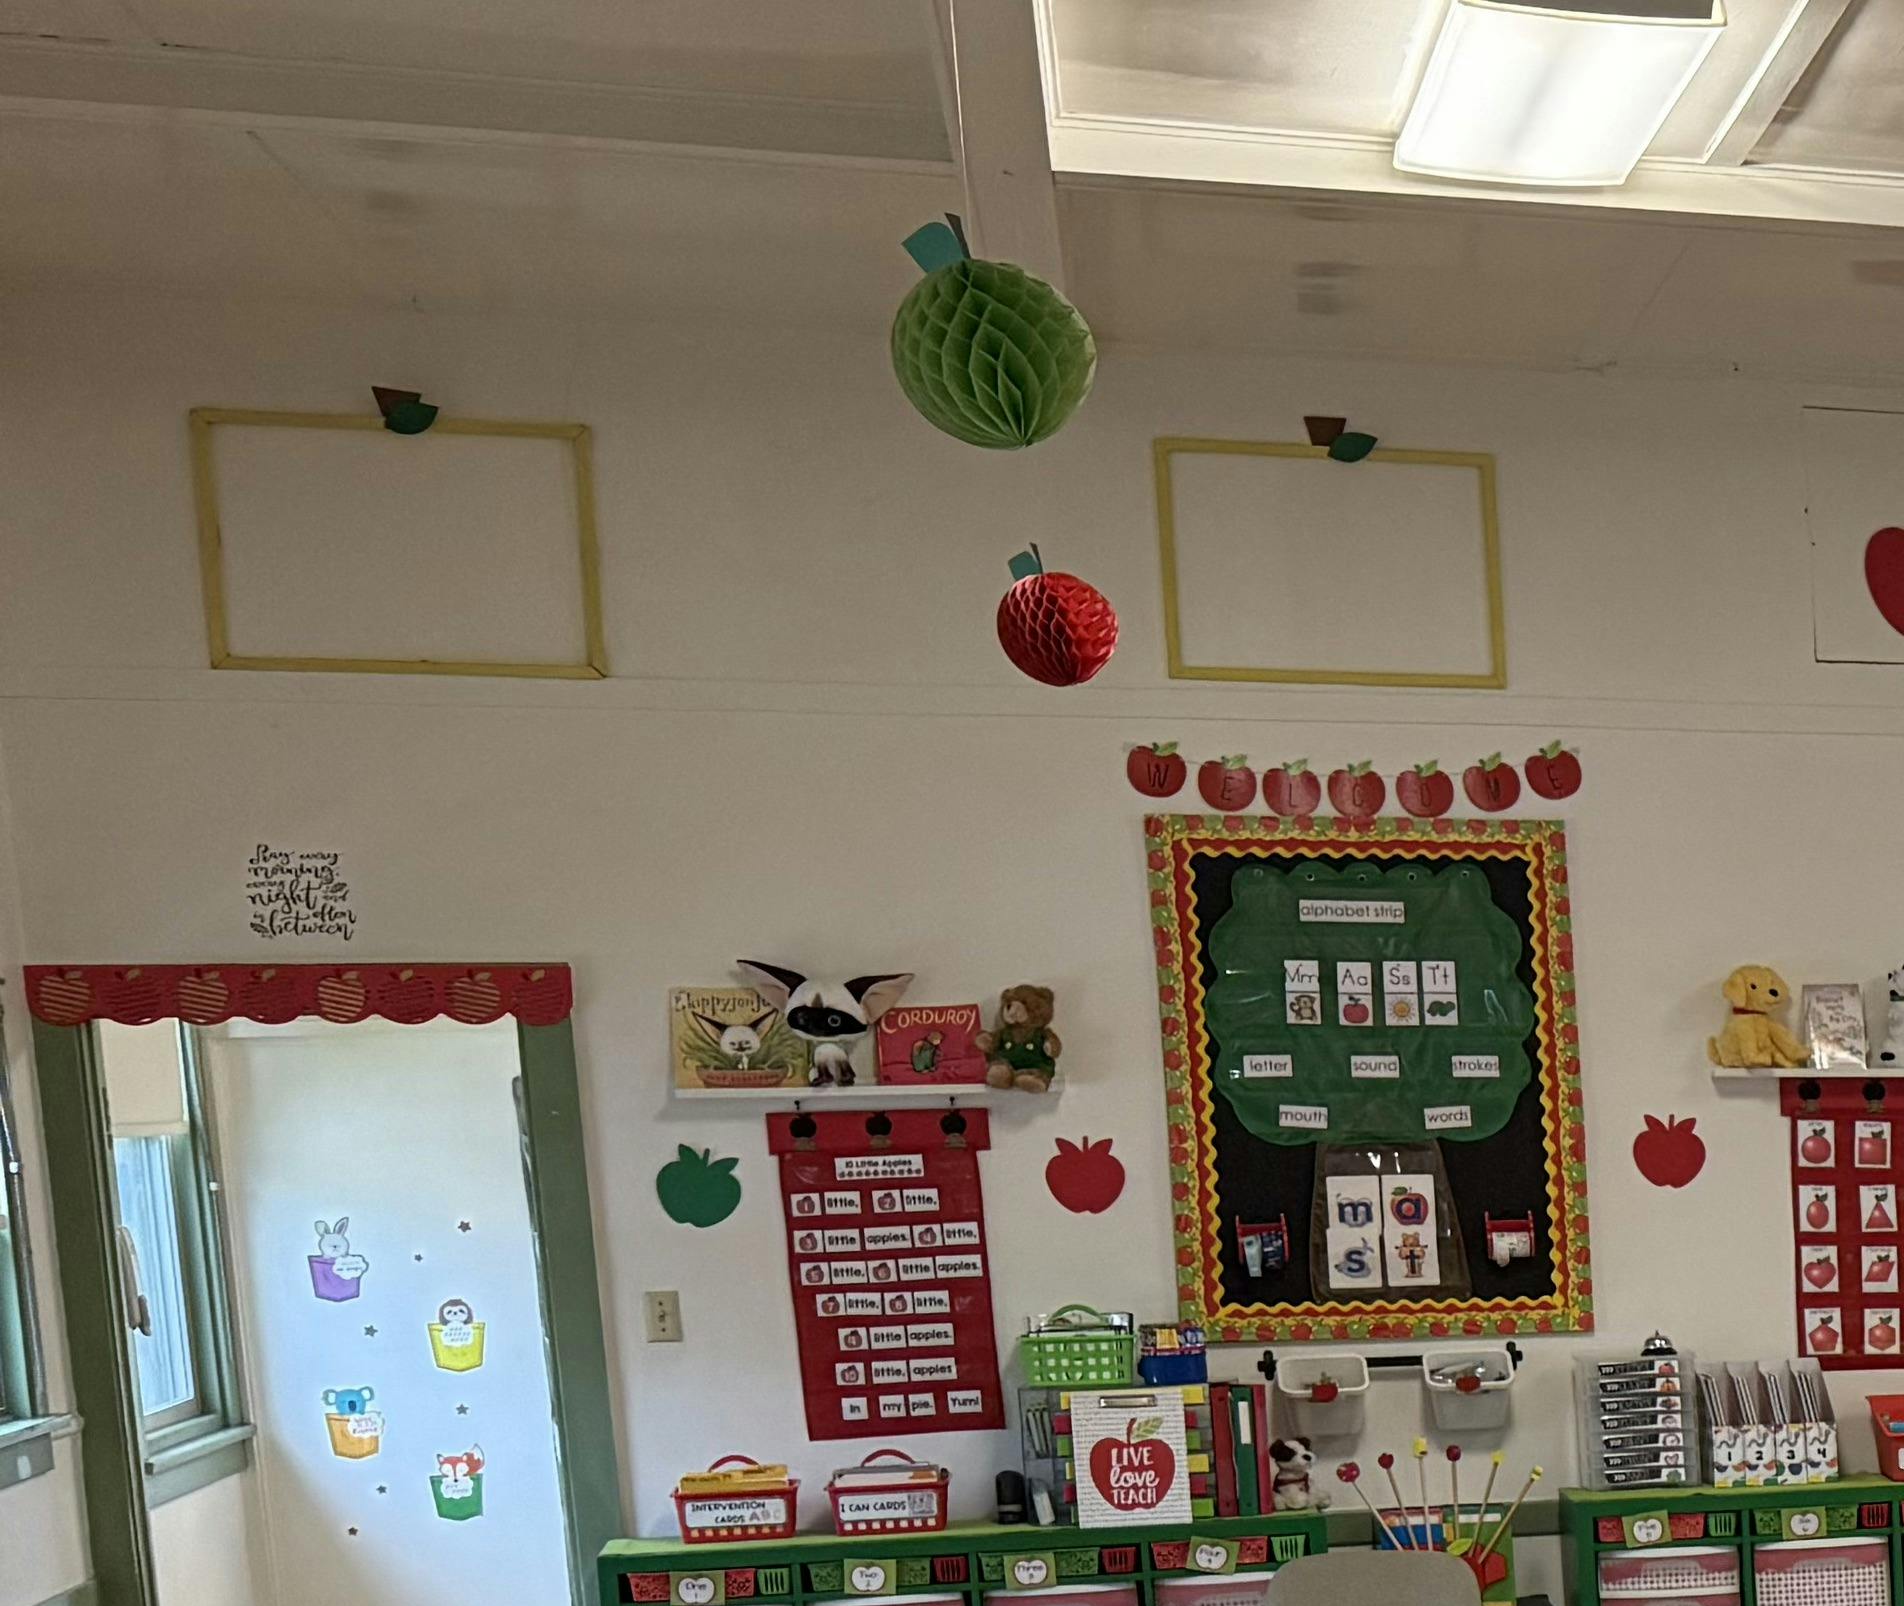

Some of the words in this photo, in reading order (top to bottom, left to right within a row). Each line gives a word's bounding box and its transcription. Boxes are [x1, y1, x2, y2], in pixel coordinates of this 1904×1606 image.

[1147, 760, 1564, 808] WELCOME
[247, 880, 320, 914] night
[1300, 903, 1370, 920] alphabet
[1374, 903, 1403, 921] strip
[1285, 963, 1319, 984] Mm
[1341, 966, 1369, 986] Aa
[1389, 965, 1411, 985] Ss
[1429, 965, 1449, 985] Tt
[882, 1009, 977, 1034] CORDUROY
[1249, 1058, 1288, 1073] letter
[1353, 1058, 1398, 1073] sound
[1452, 1058, 1499, 1073] strokes
[1280, 1109, 1328, 1123] mouth
[1427, 1109, 1469, 1123] words
[1338, 1199, 1374, 1219] m
[1394, 1197, 1425, 1218] a
[1346, 1250, 1365, 1272] s
[1404, 1246, 1421, 1274] t
[1111, 1447, 1151, 1467] LIVE
[1726, 1450, 1731, 1462] 1
[1755, 1450, 1764, 1461] 2
[1786, 1449, 1795, 1460] 3
[1817, 1446, 1827, 1459] 4
[1109, 1465, 1160, 1490] love
[1111, 1487, 1156, 1505] TEACH
[691, 1500, 766, 1512] INTERVENTION
[841, 1503, 846, 1513] I
[850, 1502, 871, 1512] CAN
[873, 1500, 906, 1512] CARDS
[715, 1515, 745, 1524] CARDS
